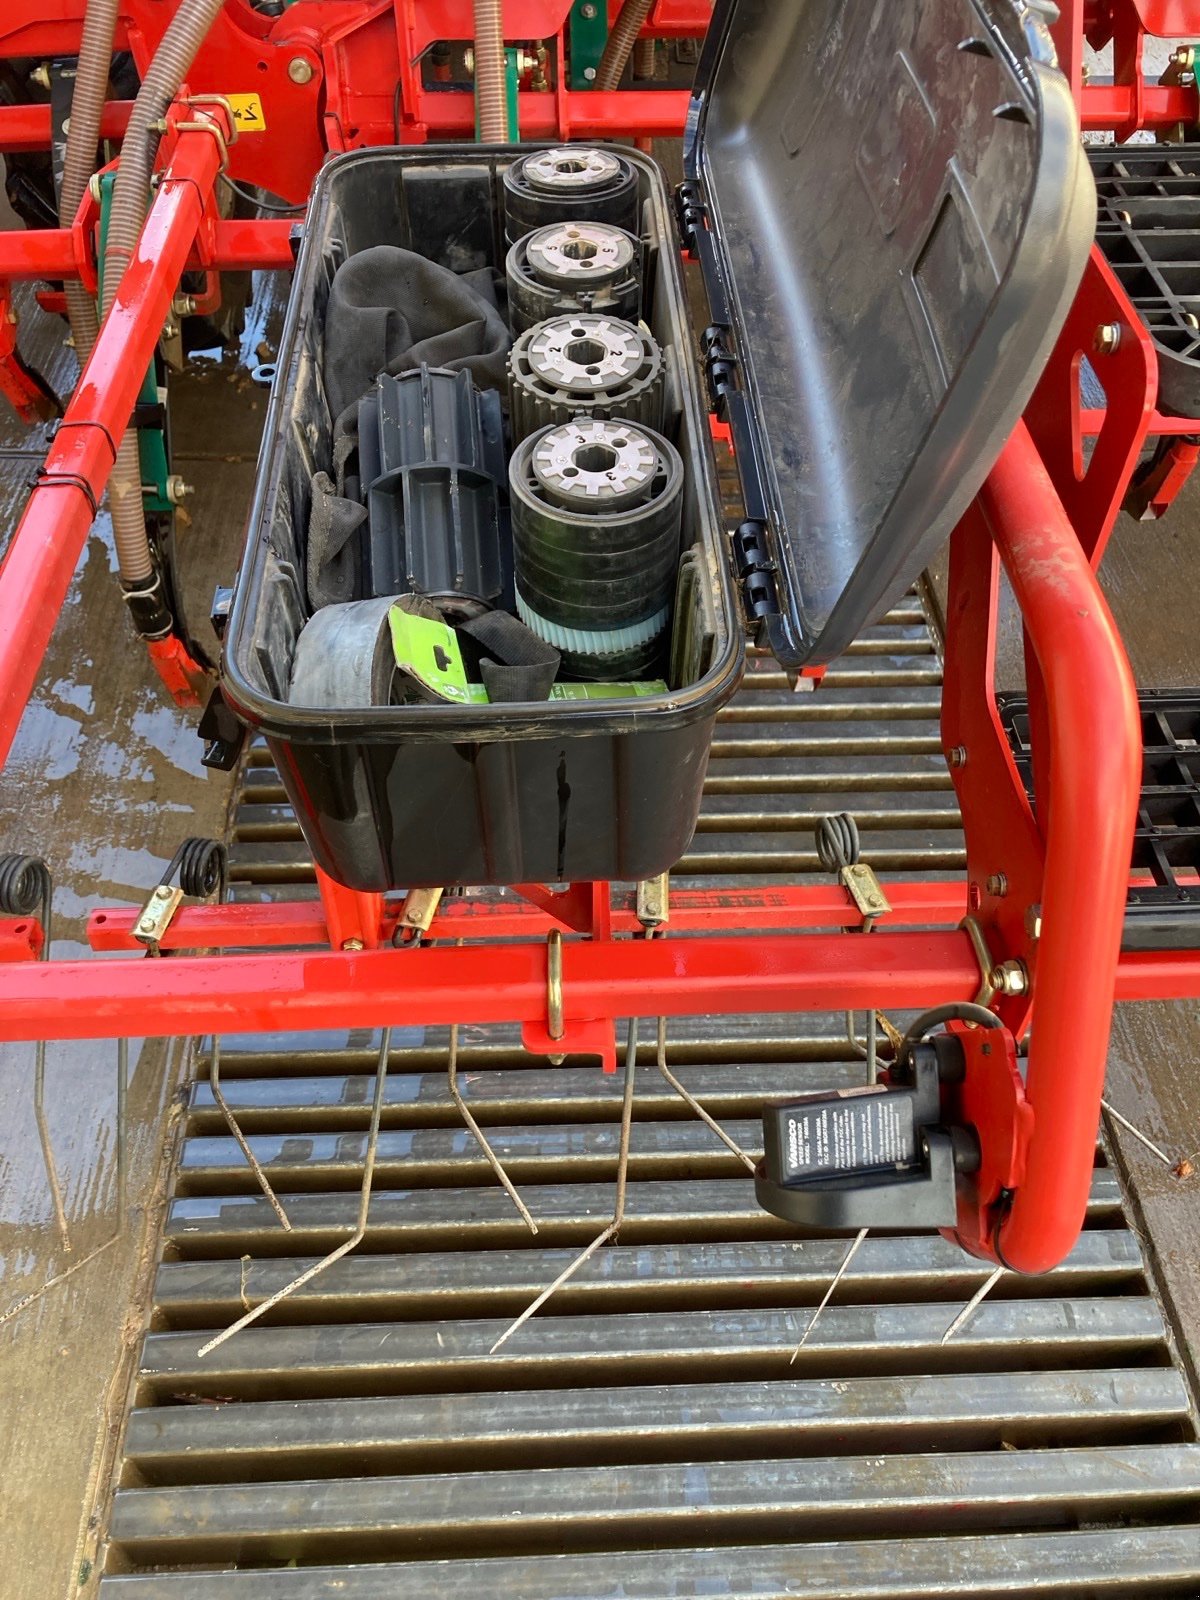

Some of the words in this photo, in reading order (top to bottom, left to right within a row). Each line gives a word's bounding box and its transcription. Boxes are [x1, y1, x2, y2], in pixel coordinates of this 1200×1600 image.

[575, 435, 586, 444] 3
[606, 472, 616, 481] 3
[789, 1119, 797, 1168] VANSCO
